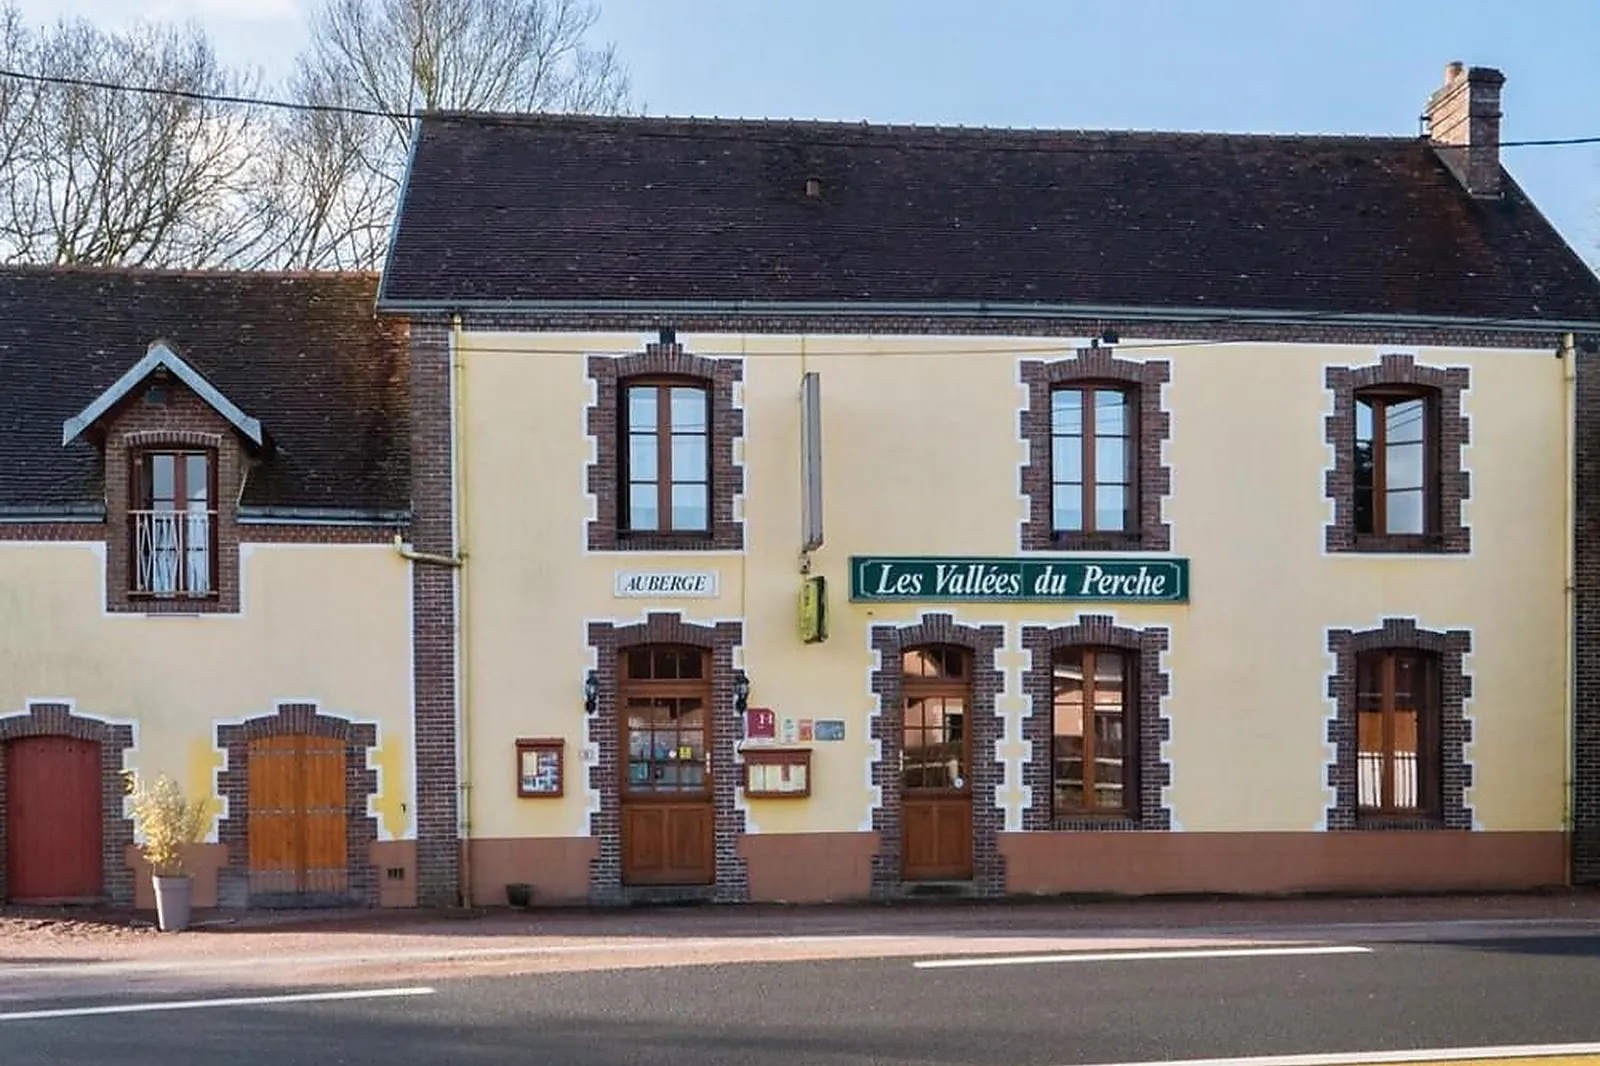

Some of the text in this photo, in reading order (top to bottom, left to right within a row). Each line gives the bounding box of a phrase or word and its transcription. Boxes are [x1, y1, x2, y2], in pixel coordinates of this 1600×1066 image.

[625, 575, 707, 591] AUBERGE
[877, 564, 1166, 595] Les Vallées du Perche
